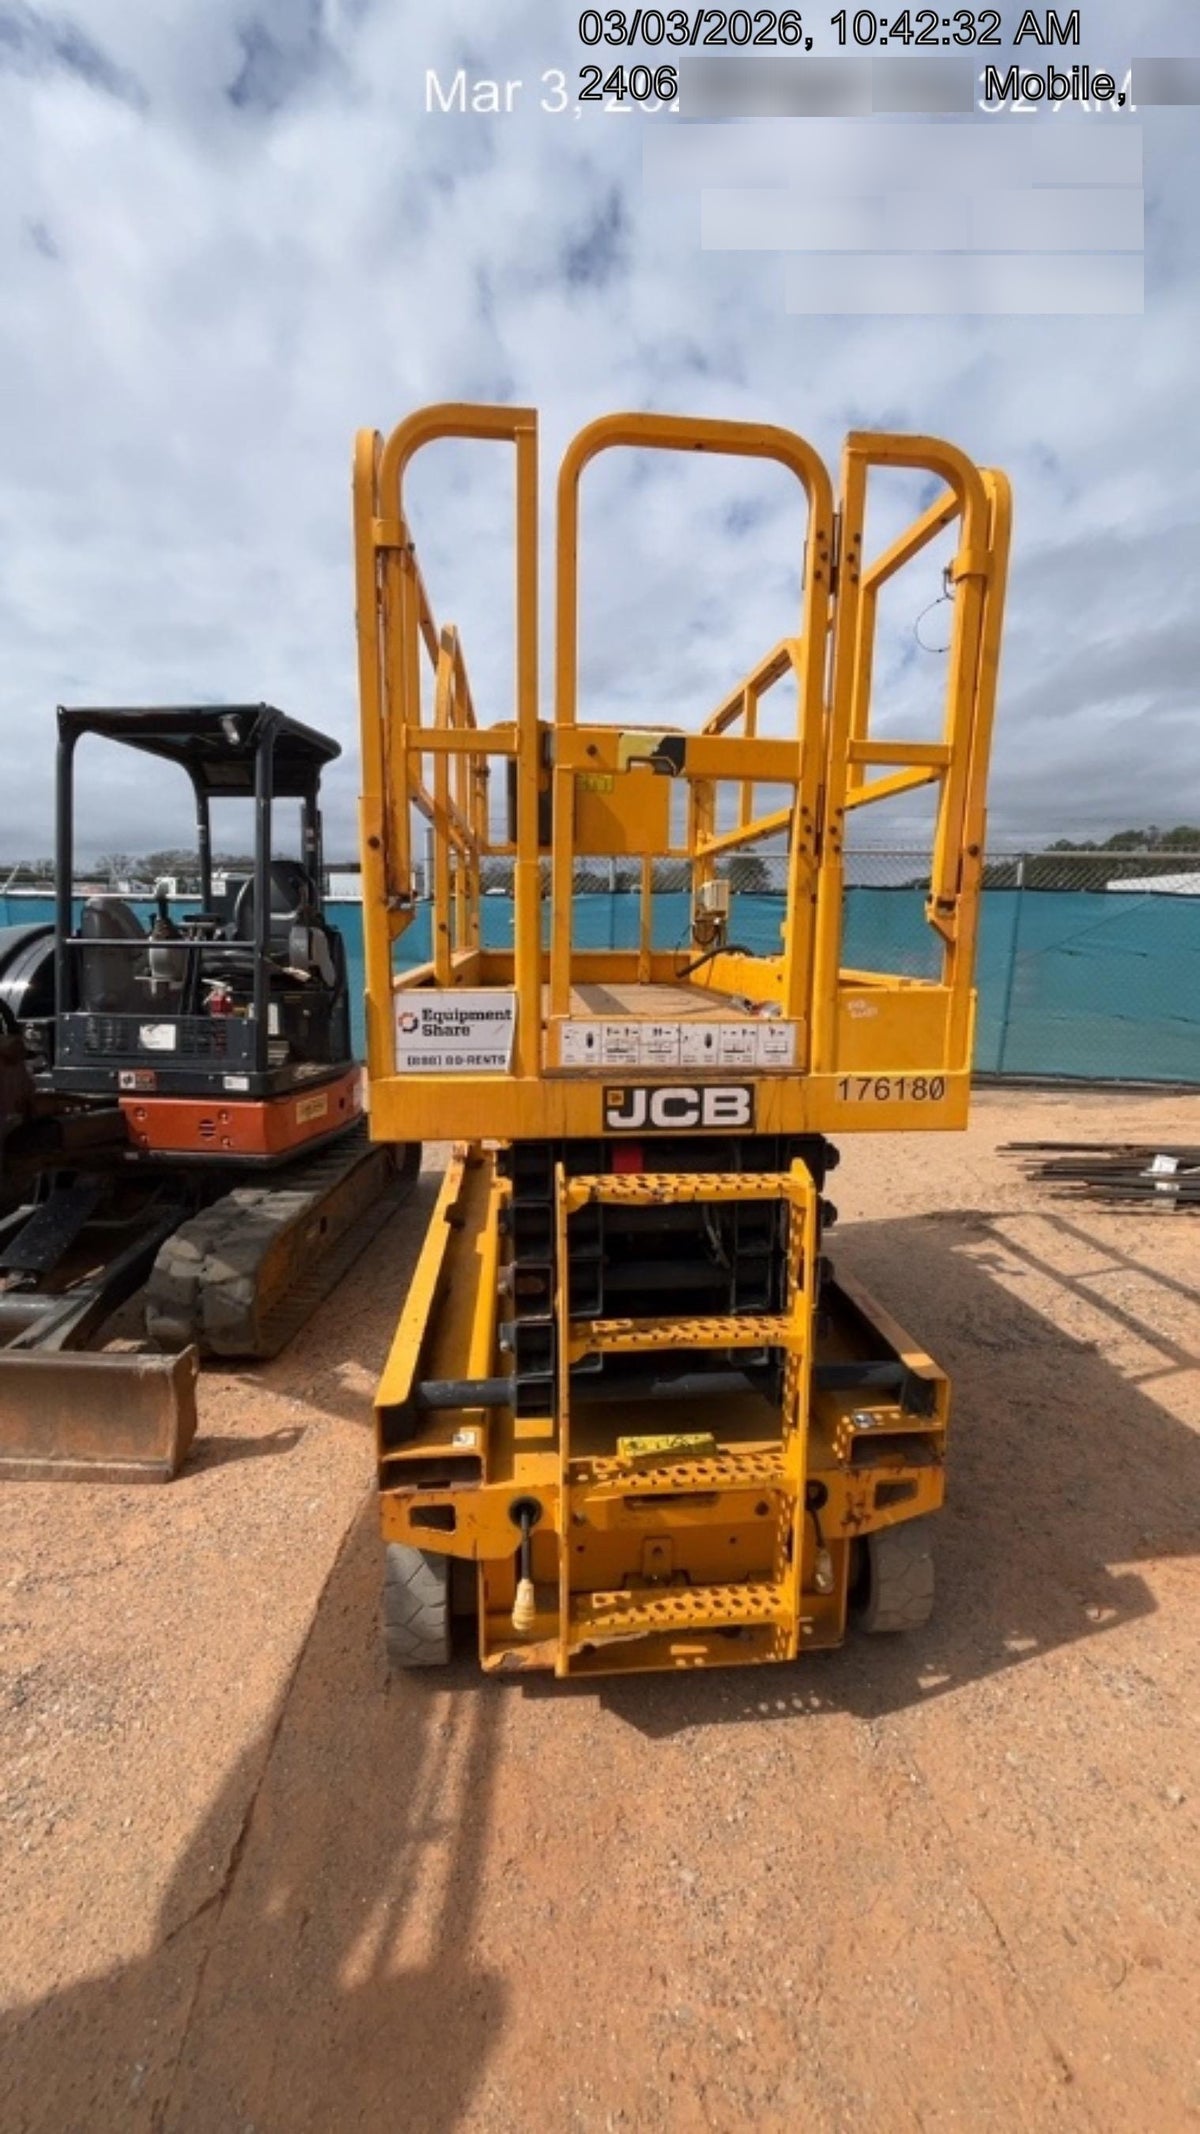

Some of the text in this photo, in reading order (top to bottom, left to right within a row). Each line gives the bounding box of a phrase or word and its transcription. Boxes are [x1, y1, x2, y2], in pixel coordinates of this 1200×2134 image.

[421, 1008, 513, 1025] Equipment
[421, 1023, 471, 1037] Share
[838, 1076, 945, 1101] 176180
[606, 1087, 751, 1128] JCB
